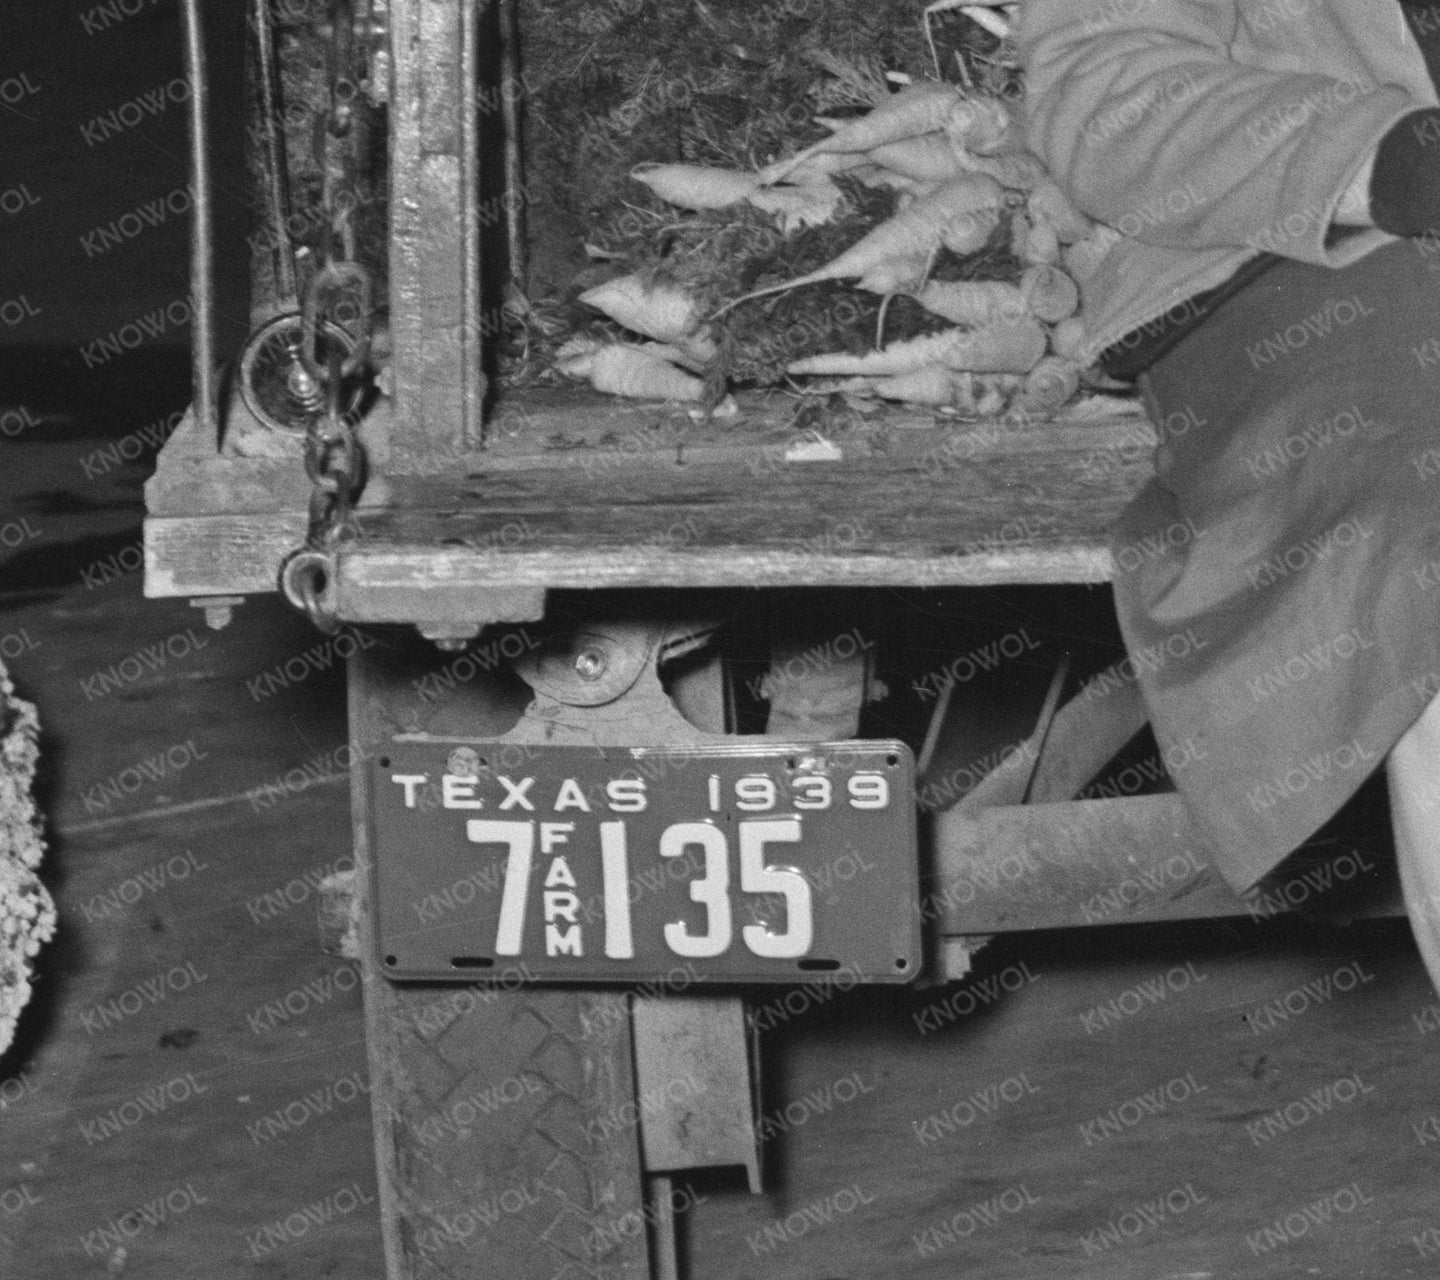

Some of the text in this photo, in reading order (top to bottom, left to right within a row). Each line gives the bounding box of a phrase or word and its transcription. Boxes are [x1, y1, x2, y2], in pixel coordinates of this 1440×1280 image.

[391, 771, 891, 812] TEXAS 1939
[539, 821, 584, 958] FARM
